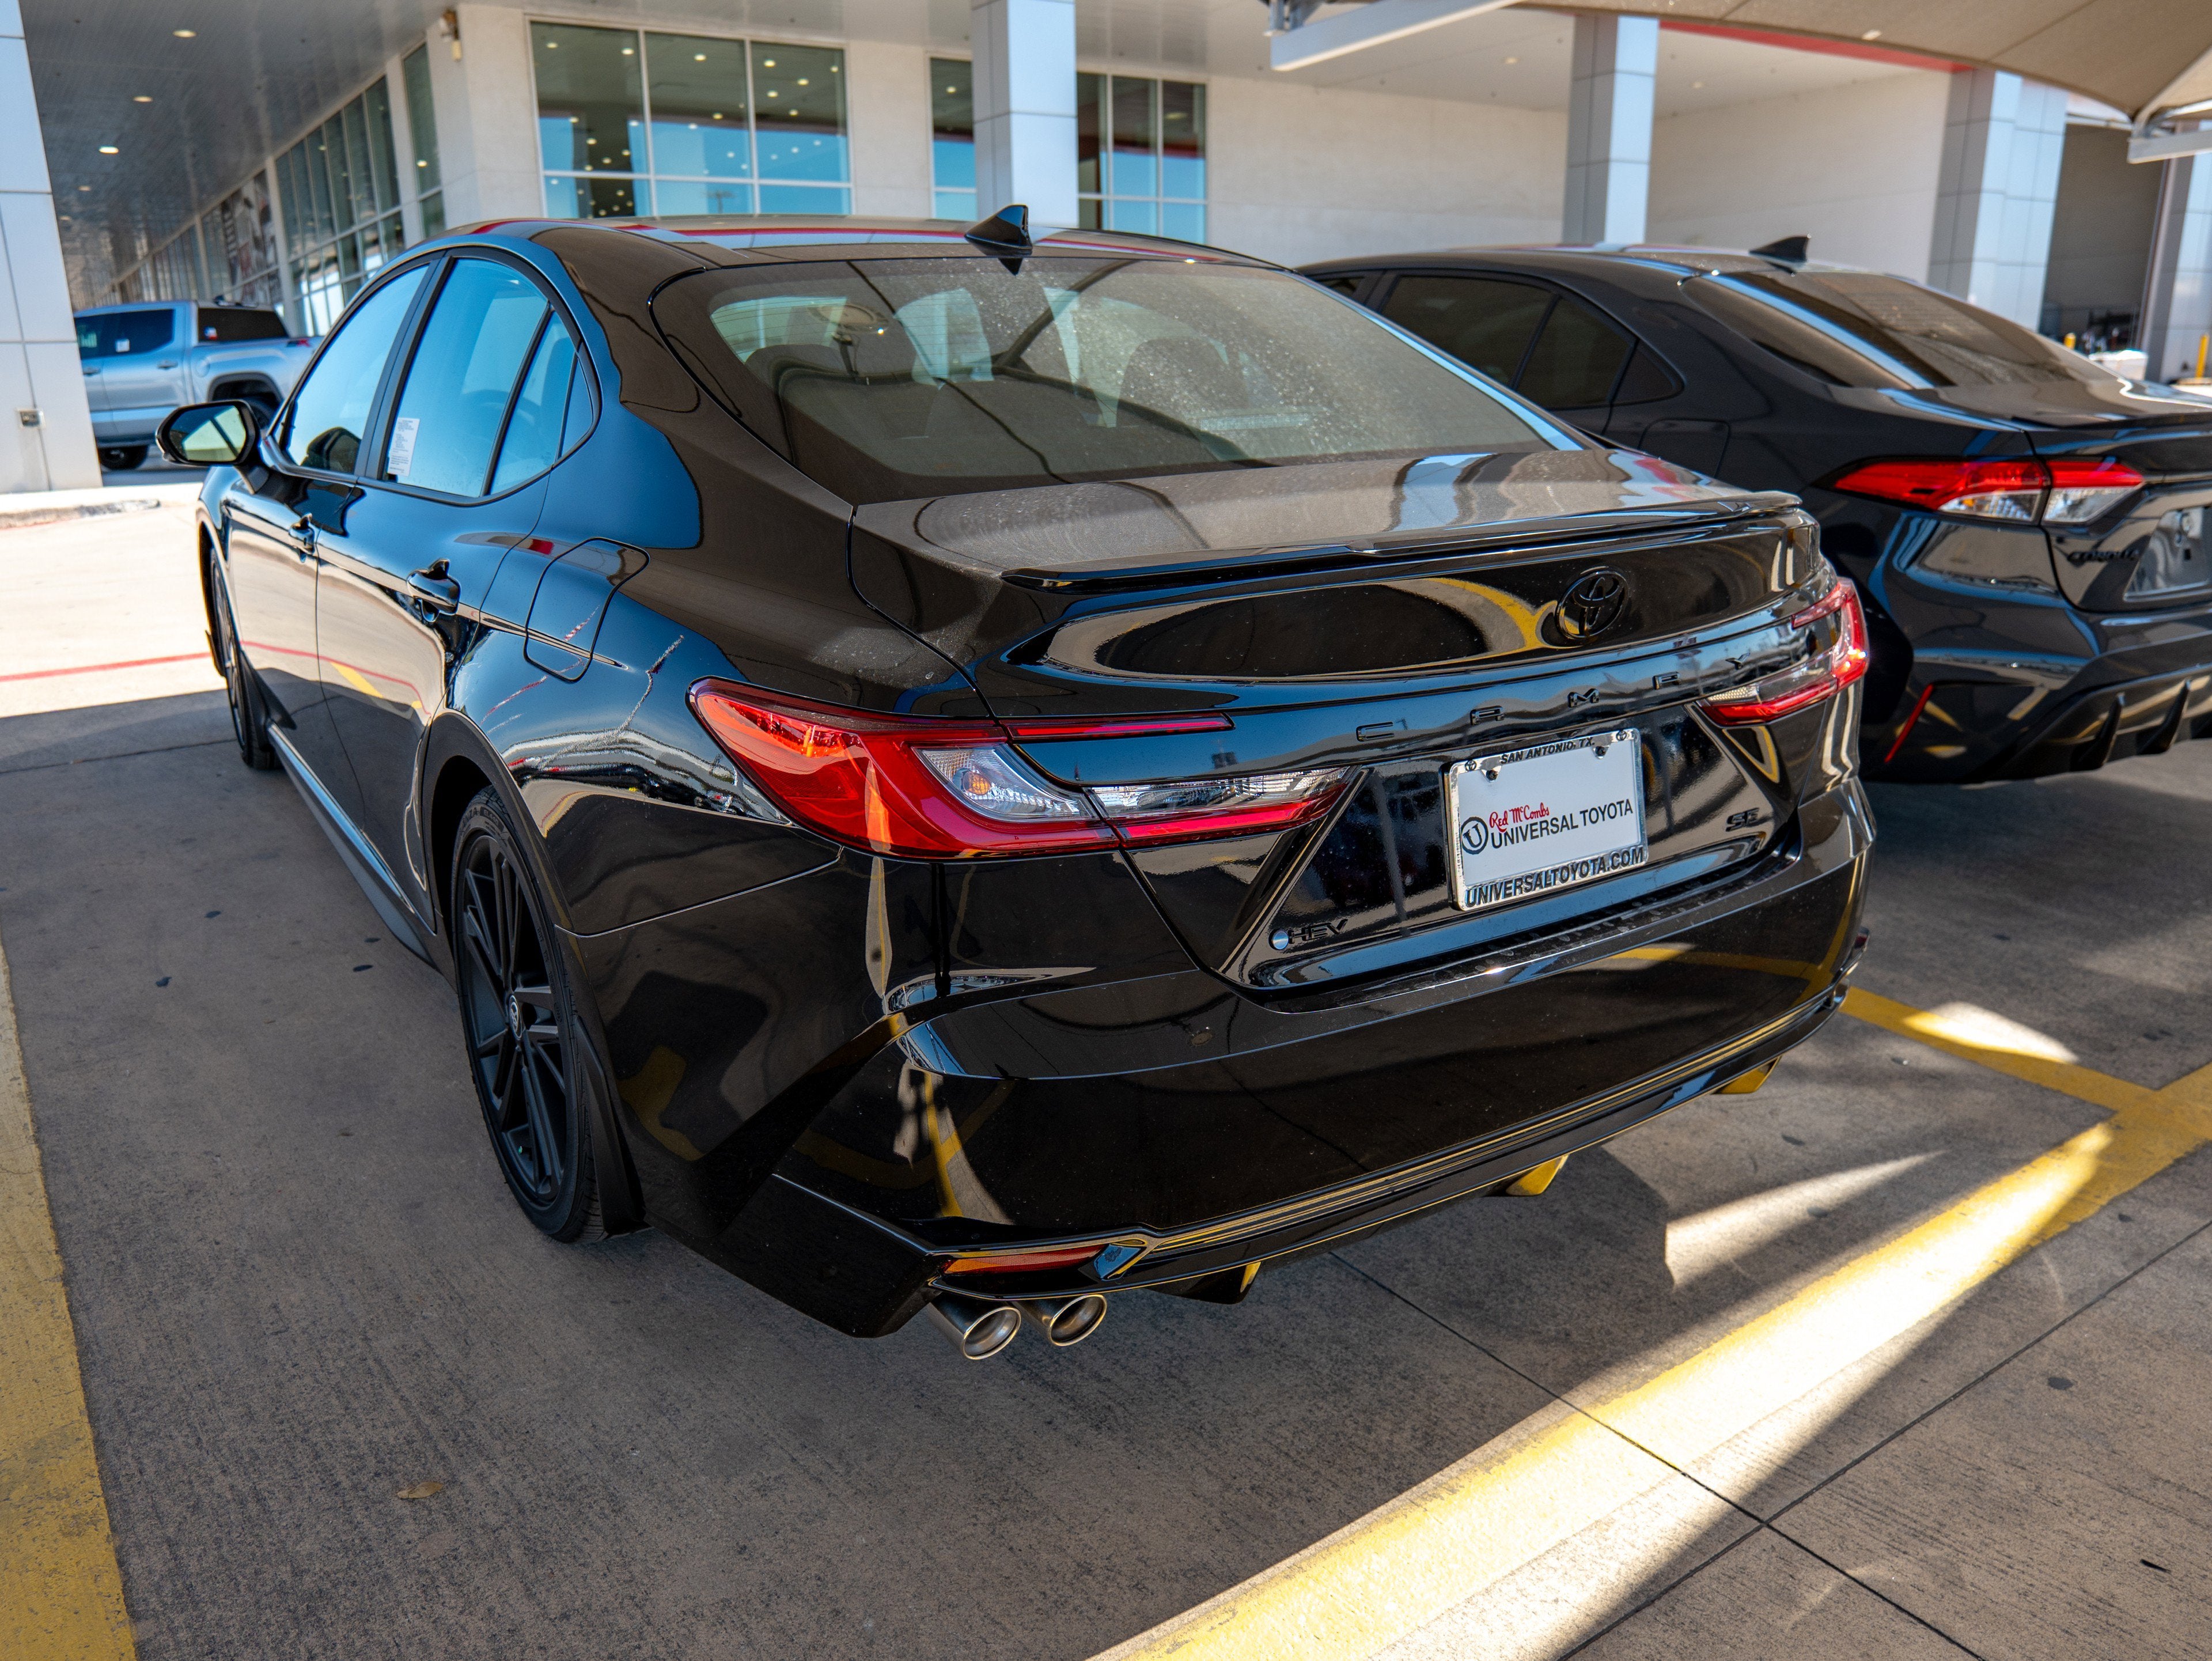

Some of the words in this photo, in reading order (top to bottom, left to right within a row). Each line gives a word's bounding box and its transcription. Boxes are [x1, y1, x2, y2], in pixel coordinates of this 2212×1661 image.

[1355, 652, 1751, 742] CAMRY
[1501, 751, 1524, 765] SAN
[1525, 740, 1577, 759] ANTONIO,
[1579, 737, 1595, 748] TX.
[1489, 811, 1509, 833] Red
[1509, 802, 1550, 823] McCombs
[1491, 815, 1578, 849] UNIVERSAL
[1580, 799, 1634, 827] TOYOTA
[1726, 807, 1760, 833] SE
[1464, 846, 1644, 908] UNIVERSALTOYOTA.COM
[1287, 918, 1349, 944] HEV
